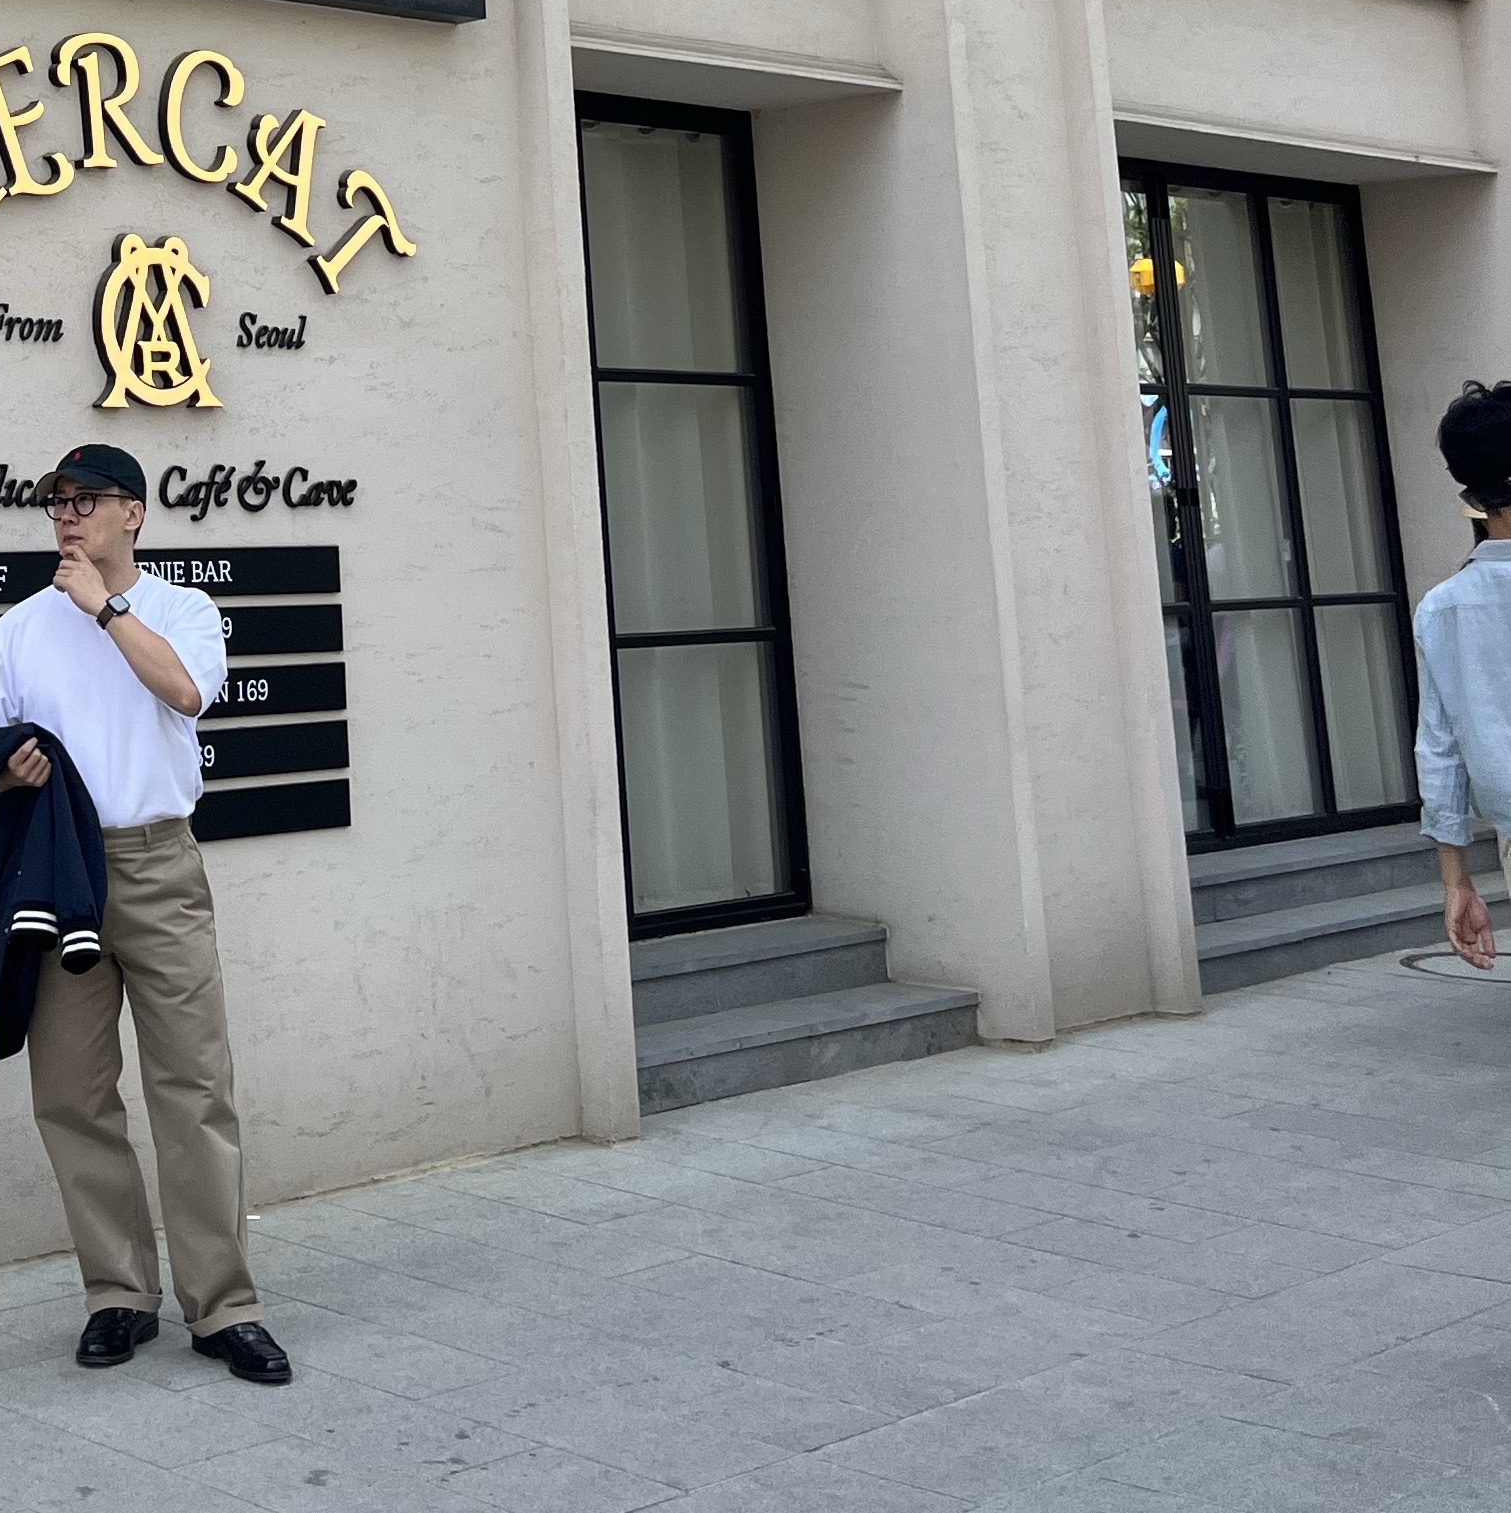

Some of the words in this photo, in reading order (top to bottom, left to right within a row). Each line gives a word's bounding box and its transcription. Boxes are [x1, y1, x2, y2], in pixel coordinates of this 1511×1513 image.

[236, 311, 307, 350] Seoul
[158, 464, 236, 521] Café
[237, 460, 280, 512] &
[282, 466, 357, 508] Cave
[190, 560, 233, 583] BAR
[236, 678, 269, 702] 169
